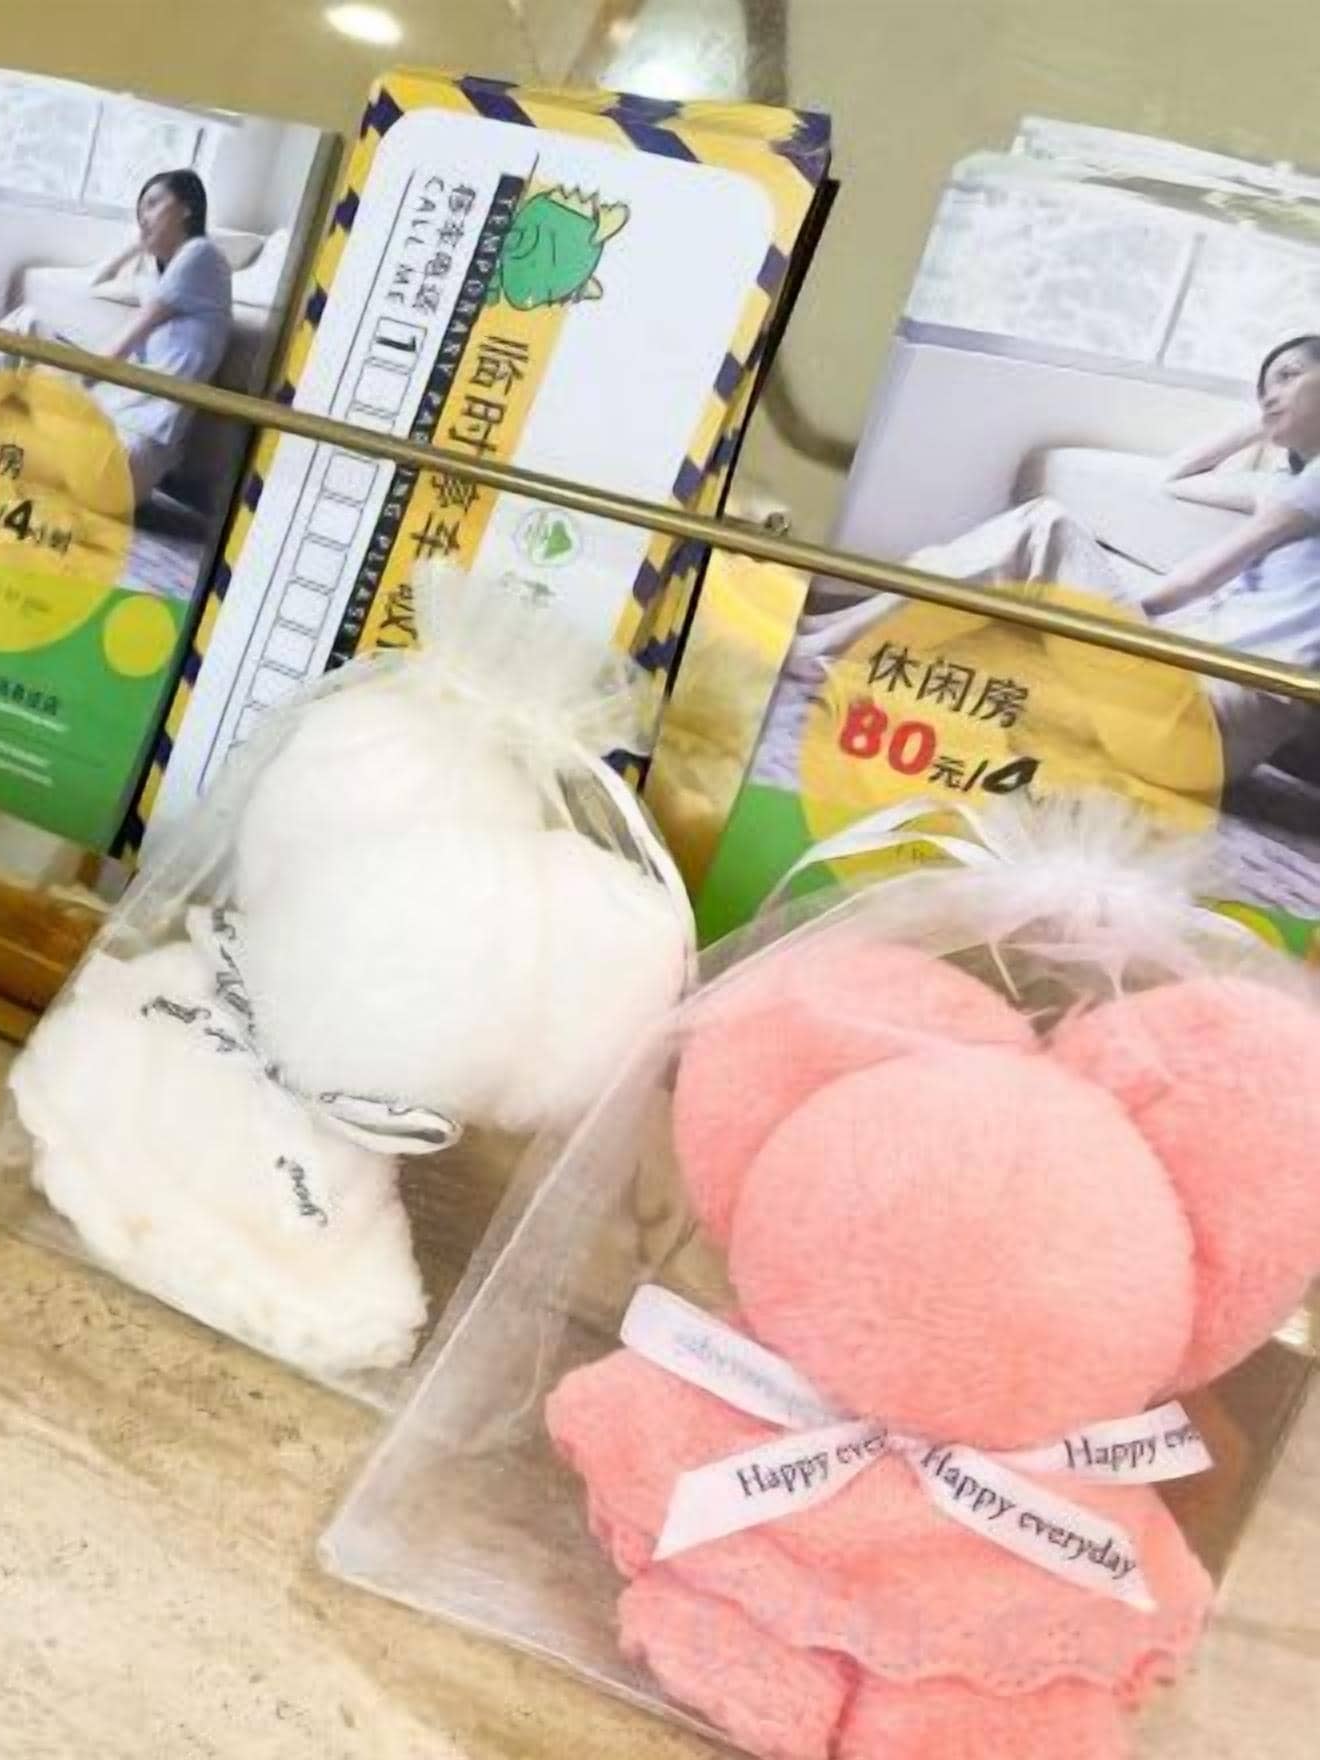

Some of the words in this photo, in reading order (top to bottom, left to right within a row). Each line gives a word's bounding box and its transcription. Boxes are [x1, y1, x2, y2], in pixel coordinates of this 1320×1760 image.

[404, 175, 445, 246] CALL
[388, 264, 415, 303] ME
[435, 195, 517, 374] TEMPORARY
[376, 335, 417, 352] 1
[867, 641, 1029, 728] 休闲房
[736, 1452, 829, 1496] Happy
[1063, 1434, 1158, 1472] Happy
[920, 1440, 1016, 1520] Happy
[1018, 1511, 1137, 1580] everyday
